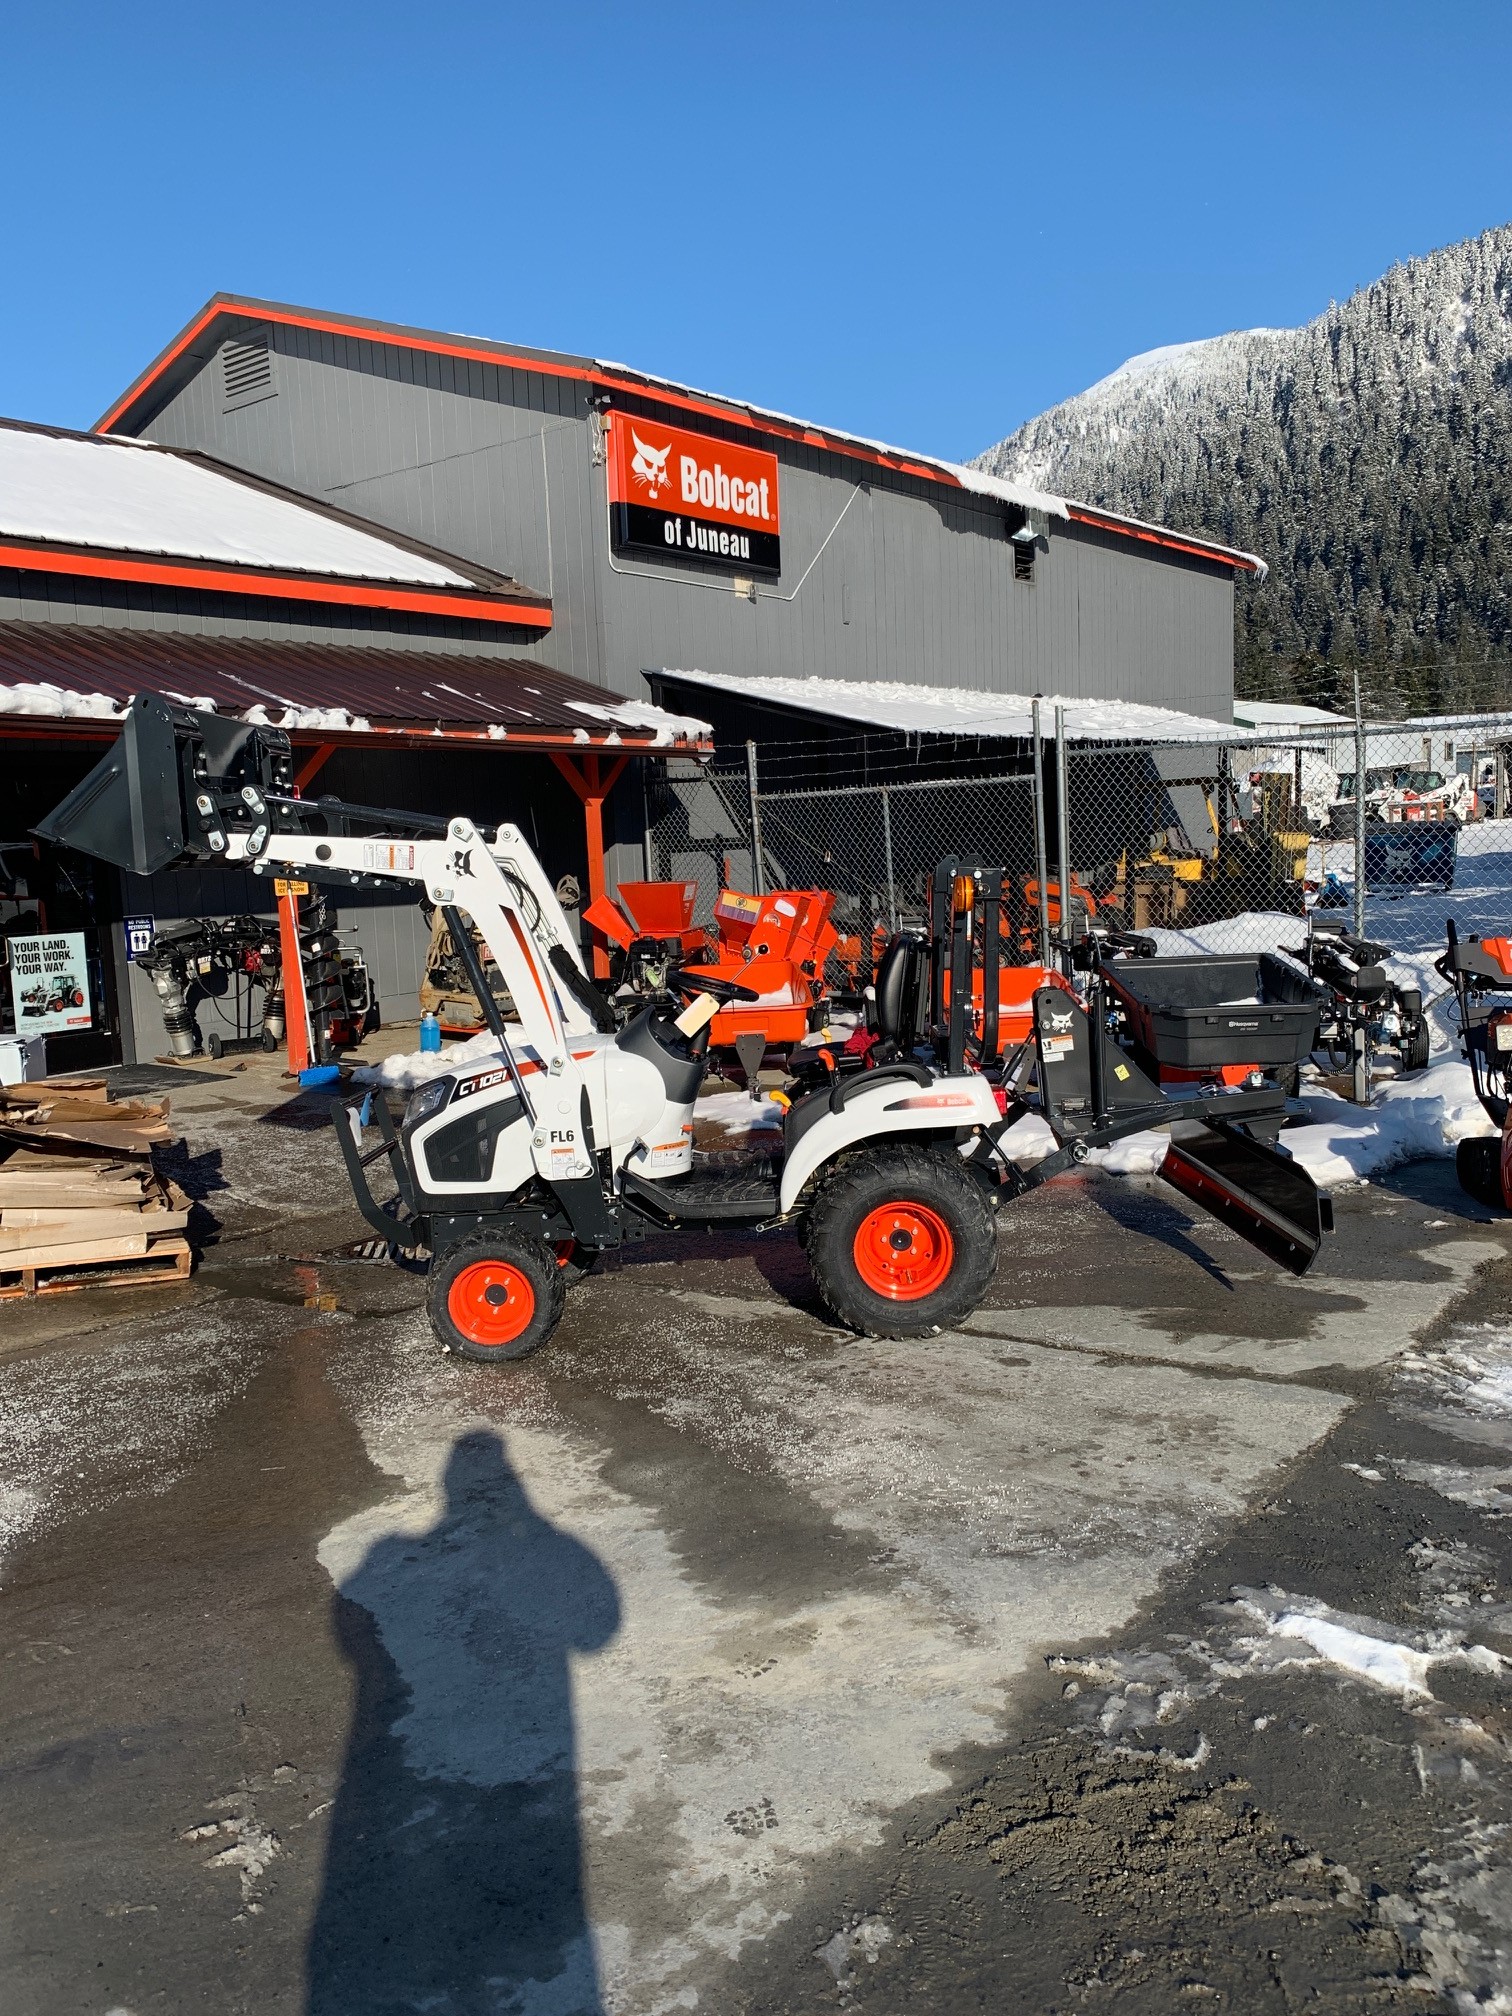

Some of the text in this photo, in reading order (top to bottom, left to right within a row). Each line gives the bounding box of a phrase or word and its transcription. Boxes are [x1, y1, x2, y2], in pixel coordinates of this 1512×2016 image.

[680, 455, 769, 520] Bobcat
[664, 518, 750, 558] of Juneau
[14, 939, 70, 953] YOUR LAND.
[15, 950, 74, 964] YOUR WORK.
[16, 962, 67, 975] YOUR WAY.
[459, 1069, 507, 1096] CT1021
[550, 1130, 575, 1143] FL6
